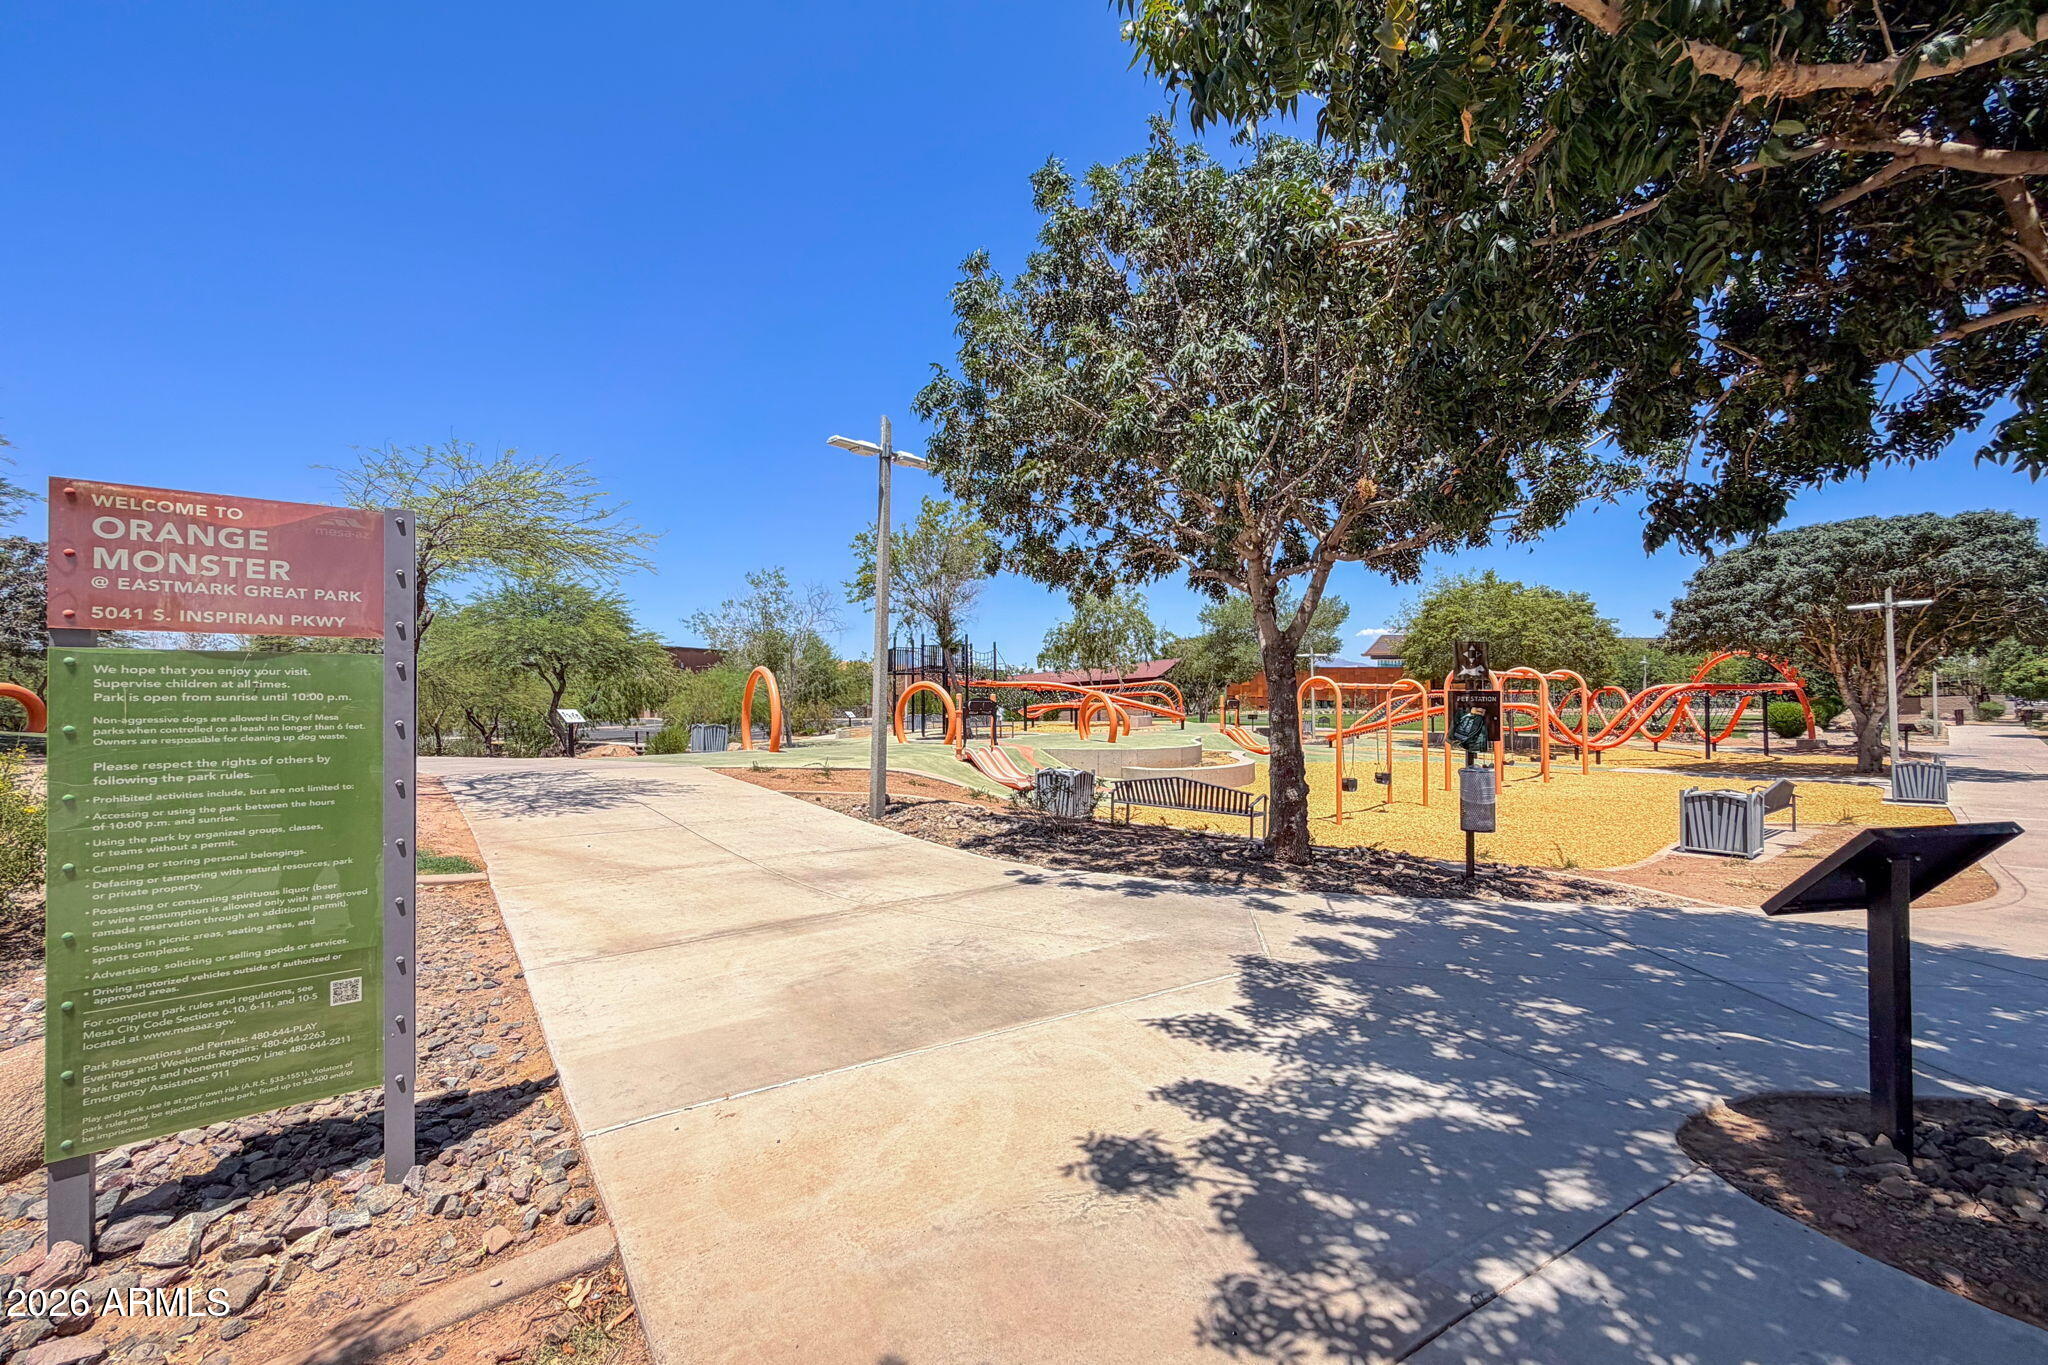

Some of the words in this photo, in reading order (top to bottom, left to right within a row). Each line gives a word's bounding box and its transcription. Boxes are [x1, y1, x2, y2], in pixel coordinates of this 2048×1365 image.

[92, 494, 207, 516] WELCOME
[215, 506, 244, 520] TO
[92, 516, 268, 551] ORANGE
[93, 547, 290, 581] MONSTER
[91, 577, 109, 588] @
[118, 577, 237, 596] EASTMARK
[244, 586, 307, 600] GREAT
[314, 589, 362, 602] PARK
[91, 606, 143, 620] 5041
[152, 609, 171, 622] S.
[180, 610, 283, 626] INSPIRIAN
[291, 615, 346, 628] PKWY
[93, 665, 116, 673] We
[120, 665, 156, 676] hope
[159, 666, 187, 674] that
[217, 667, 251, 677] enjoy
[93, 679, 161, 690] Supervise
[165, 679, 217, 687] children
[93, 693, 126, 701] Park
[128, 693, 139, 701] is
[143, 696, 177, 704] open
[181, 693, 211, 701] from
[93, 716, 179, 725] Non-aggressive
[181, 715, 208, 724] dogs
[280, 714, 300, 722] City
[160, 735, 220, 745] responsible
[239, 734, 280, 743] cleaning
[297, 733, 316, 742] dog
[93, 762, 138, 771] Please
[142, 760, 193, 771] respect
[195, 759, 217, 767] the
[221, 757, 257, 768] rights
[260, 756, 273, 764] of
[276, 756, 314, 764] others
[316, 755, 330, 764] by
[92, 775, 158, 785] following
[162, 773, 184, 782] the
[187, 772, 216, 783] park
[220, 771, 253, 779] rules.
[92, 793, 152, 804] Prohibited
[155, 791, 204, 800] activities
[206, 788, 246, 797] include,
[307, 783, 340, 791] limited
[92, 838, 125, 847] Using
[128, 836, 147, 844] the
[150, 833, 175, 844] park
[177, 832, 191, 842] by
[194, 828, 245, 840] organized
[92, 863, 144, 873] Camping
[162, 858, 200, 867] storing
[203, 852, 247, 865] personal
[250, 849, 306, 859] belongings.
[108, 888, 148, 900] private
[151, 883, 202, 896] property.
[92, 926, 135, 937] ramada
[138, 918, 200, 931] reservation
[203, 911, 244, 923] through
[261, 903, 310, 916] additional
[91, 941, 142, 953] Smoking
[158, 934, 190, 946] picnic
[192, 932, 223, 940] areas,
[226, 925, 263, 935] seating
[297, 917, 315, 926] and
[91, 965, 161, 980] Advertising,
[164, 957, 212, 969] soliciting
[228, 950, 261, 960] selling
[264, 944, 295, 957] goods
[309, 938, 349, 948] services.
[92, 953, 129, 965] sports
[132, 946, 193, 958] complexes.
[93, 989, 146, 1006] approved
[148, 986, 179, 995] areas.
[83, 1020, 103, 1028] For
[106, 1010, 159, 1024] complete
[162, 1004, 186, 1017] park
[188, 1001, 214, 1010] rules
[216, 996, 235, 1006] and
[238, 989, 294, 1003] regulations,
[82, 1036, 125, 1050] located
[128, 1034, 140, 1042] at
[142, 1019, 236, 1040] www.mesaaz.gov.
[82, 1061, 108, 1073] Park
[111, 1049, 182, 1067] Reservations
[184, 1043, 204, 1053] and
[207, 1037, 248, 1049] Permits:
[250, 1022, 317, 1041] 480-644-PLAY
[82, 1069, 134, 1084] Evenings
[136, 1062, 158, 1073] and
[160, 1052, 216, 1068] Weekends
[217, 1045, 258, 1057] Repairs:
[261, 1030, 325, 1049] 480-644-2263
[82, 1088, 146, 1106] Emergency
[149, 1076, 208, 1092] Assistance:
[211, 1069, 229, 1080] 911
[81, 1123, 103, 1135] park
[105, 1119, 128, 1128] rules
[130, 1115, 150, 1123] may
[164, 1102, 197, 1116] ejected
[199, 1099, 219, 1108] from
